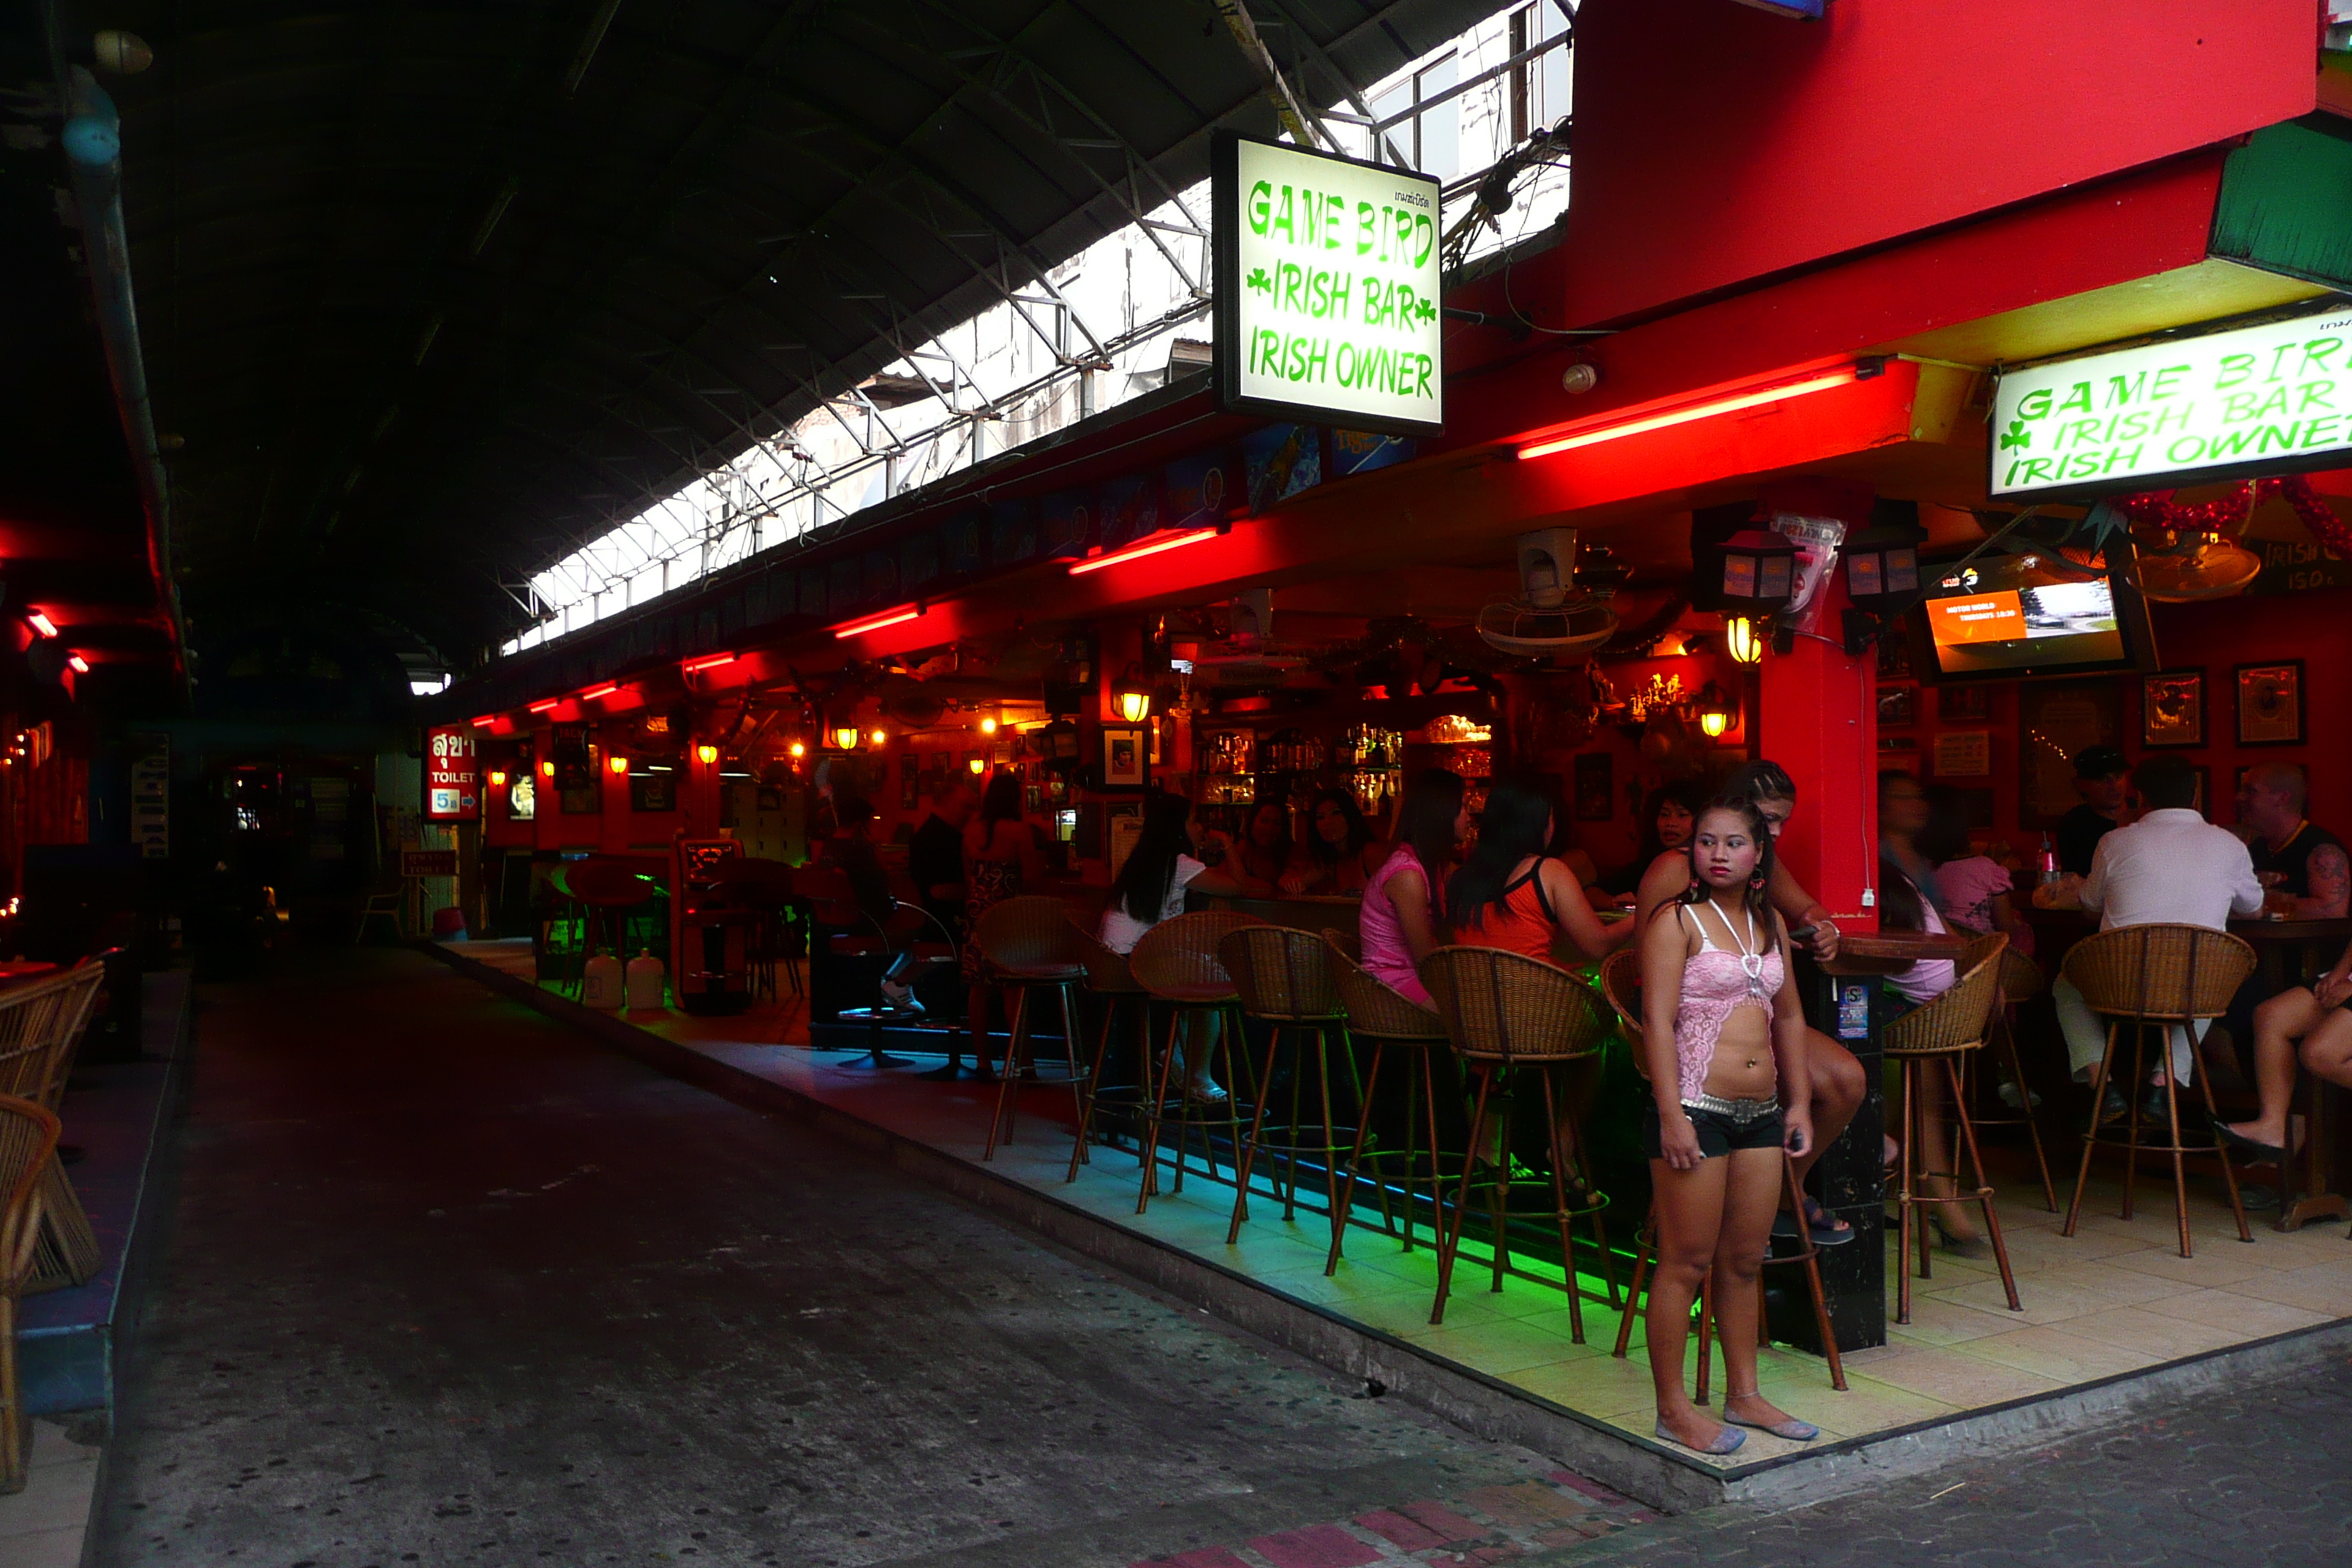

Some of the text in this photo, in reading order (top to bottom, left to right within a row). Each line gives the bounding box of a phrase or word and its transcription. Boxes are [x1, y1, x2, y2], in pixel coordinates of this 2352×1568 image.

[1248, 180, 1433, 269] GAME BIRD
[1273, 258, 1415, 333] IRISH BAR
[1249, 325, 1433, 400] IRISH OWNER
[2016, 336, 2352, 421] GAME BIR
[2052, 380, 2337, 451] IRISH BAR
[2004, 442, 2144, 486] IRISH
[1946, 601, 1996, 614] MOTOR WORLD
[431, 771, 475, 783] TOILET
